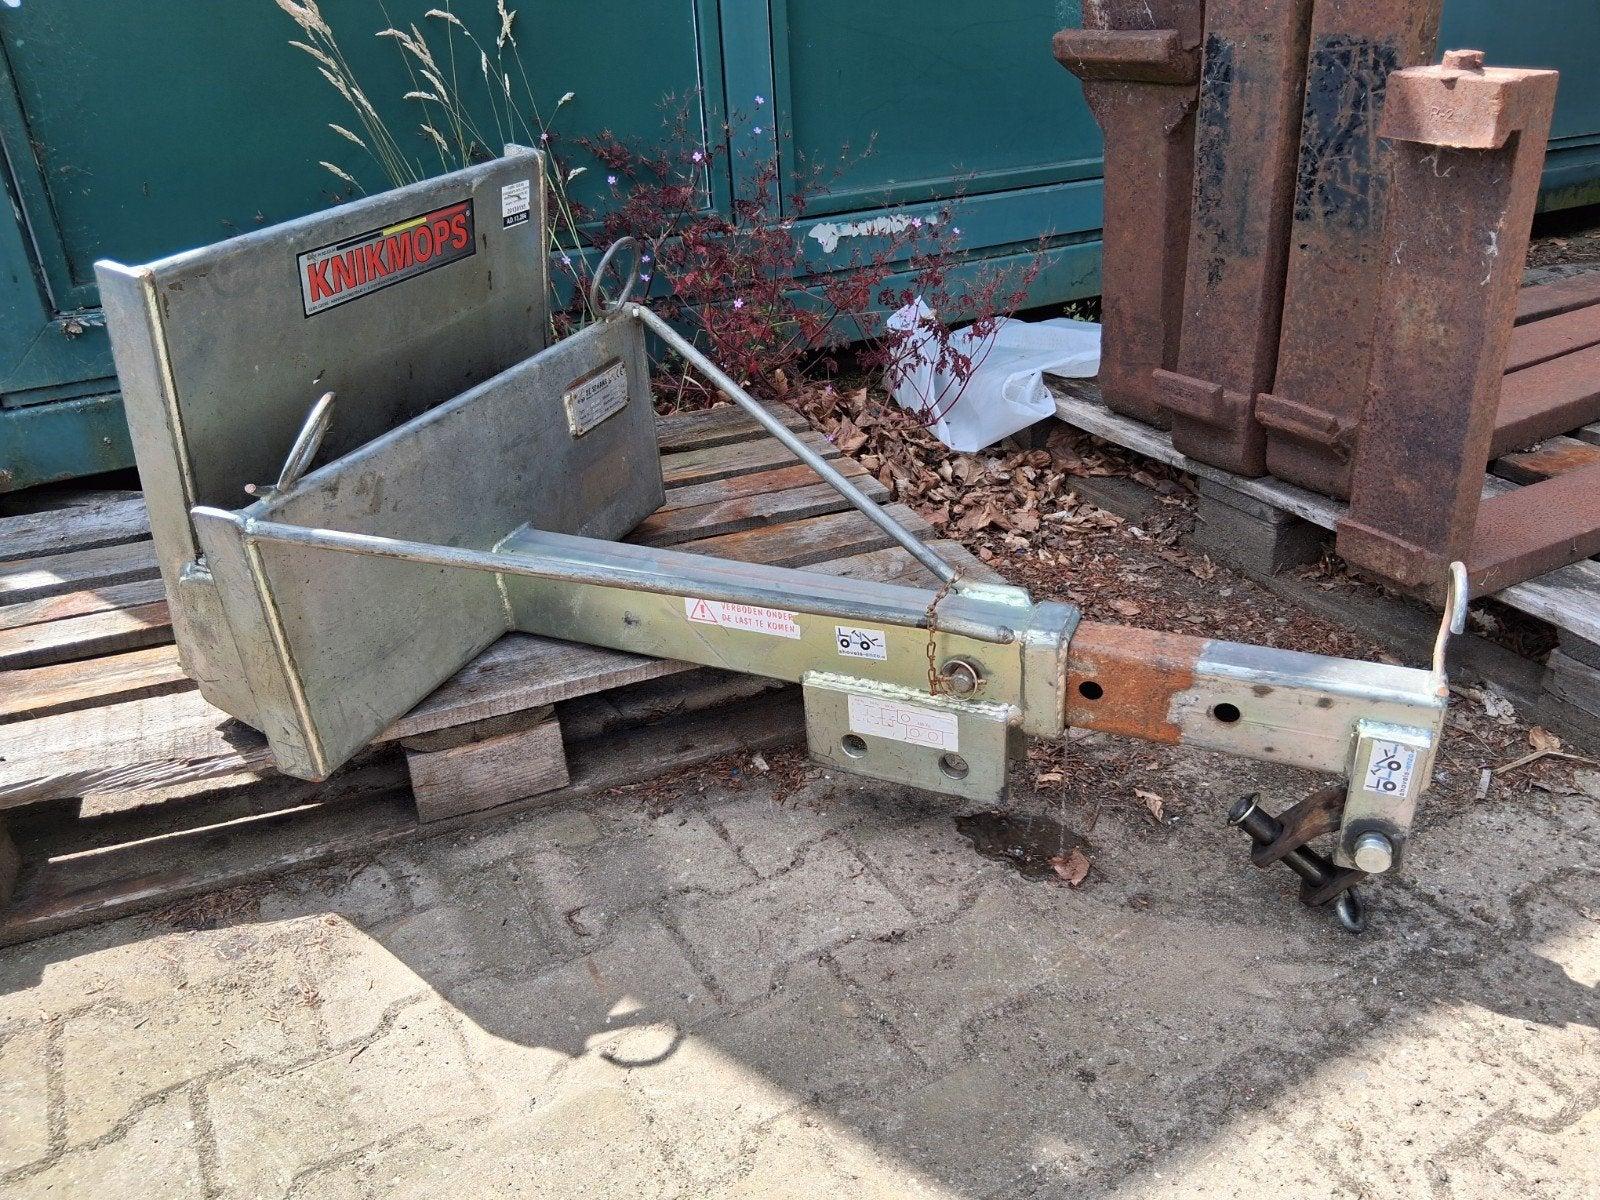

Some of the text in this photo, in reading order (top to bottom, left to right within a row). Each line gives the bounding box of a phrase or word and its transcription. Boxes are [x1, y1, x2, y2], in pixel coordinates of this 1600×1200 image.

[307, 212, 469, 303] KNIKMOPS
[721, 601, 763, 616] VERBODEN
[721, 613, 795, 633] DE LAST TE KOMEN
